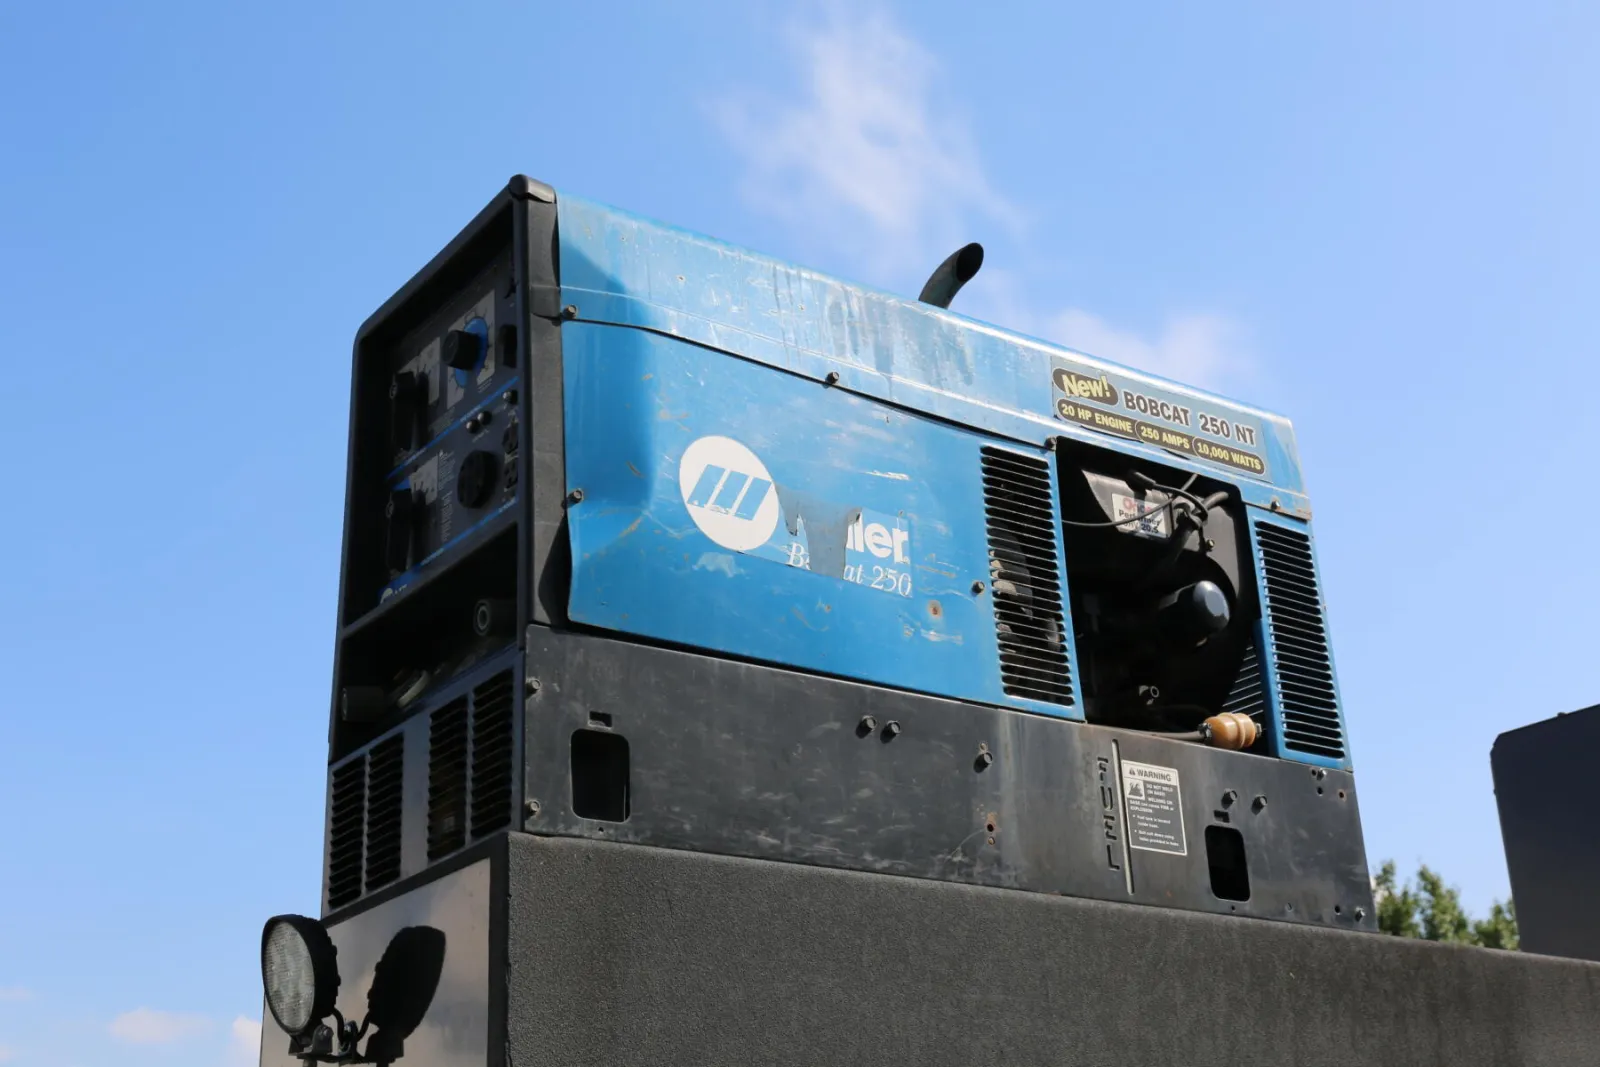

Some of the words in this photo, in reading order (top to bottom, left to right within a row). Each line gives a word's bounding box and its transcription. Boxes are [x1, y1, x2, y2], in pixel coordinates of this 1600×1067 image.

[1061, 375, 1111, 399] New!
[1061, 403, 1076, 418] 20
[1077, 407, 1093, 422] HP
[1095, 413, 1134, 434] ENGINE
[1123, 391, 1191, 427] BOBCAT
[1199, 414, 1231, 439] 250
[1235, 425, 1257, 446] NT
[1140, 425, 1160, 441] 250
[1161, 432, 1191, 450] AMPS
[1196, 442, 1231, 462] 10,000
[1231, 452, 1262, 471] WATTS
[871, 565, 912, 598] 250
[1136, 768, 1172, 782] WARNING
[1097, 756, 1120, 871] FUEL
